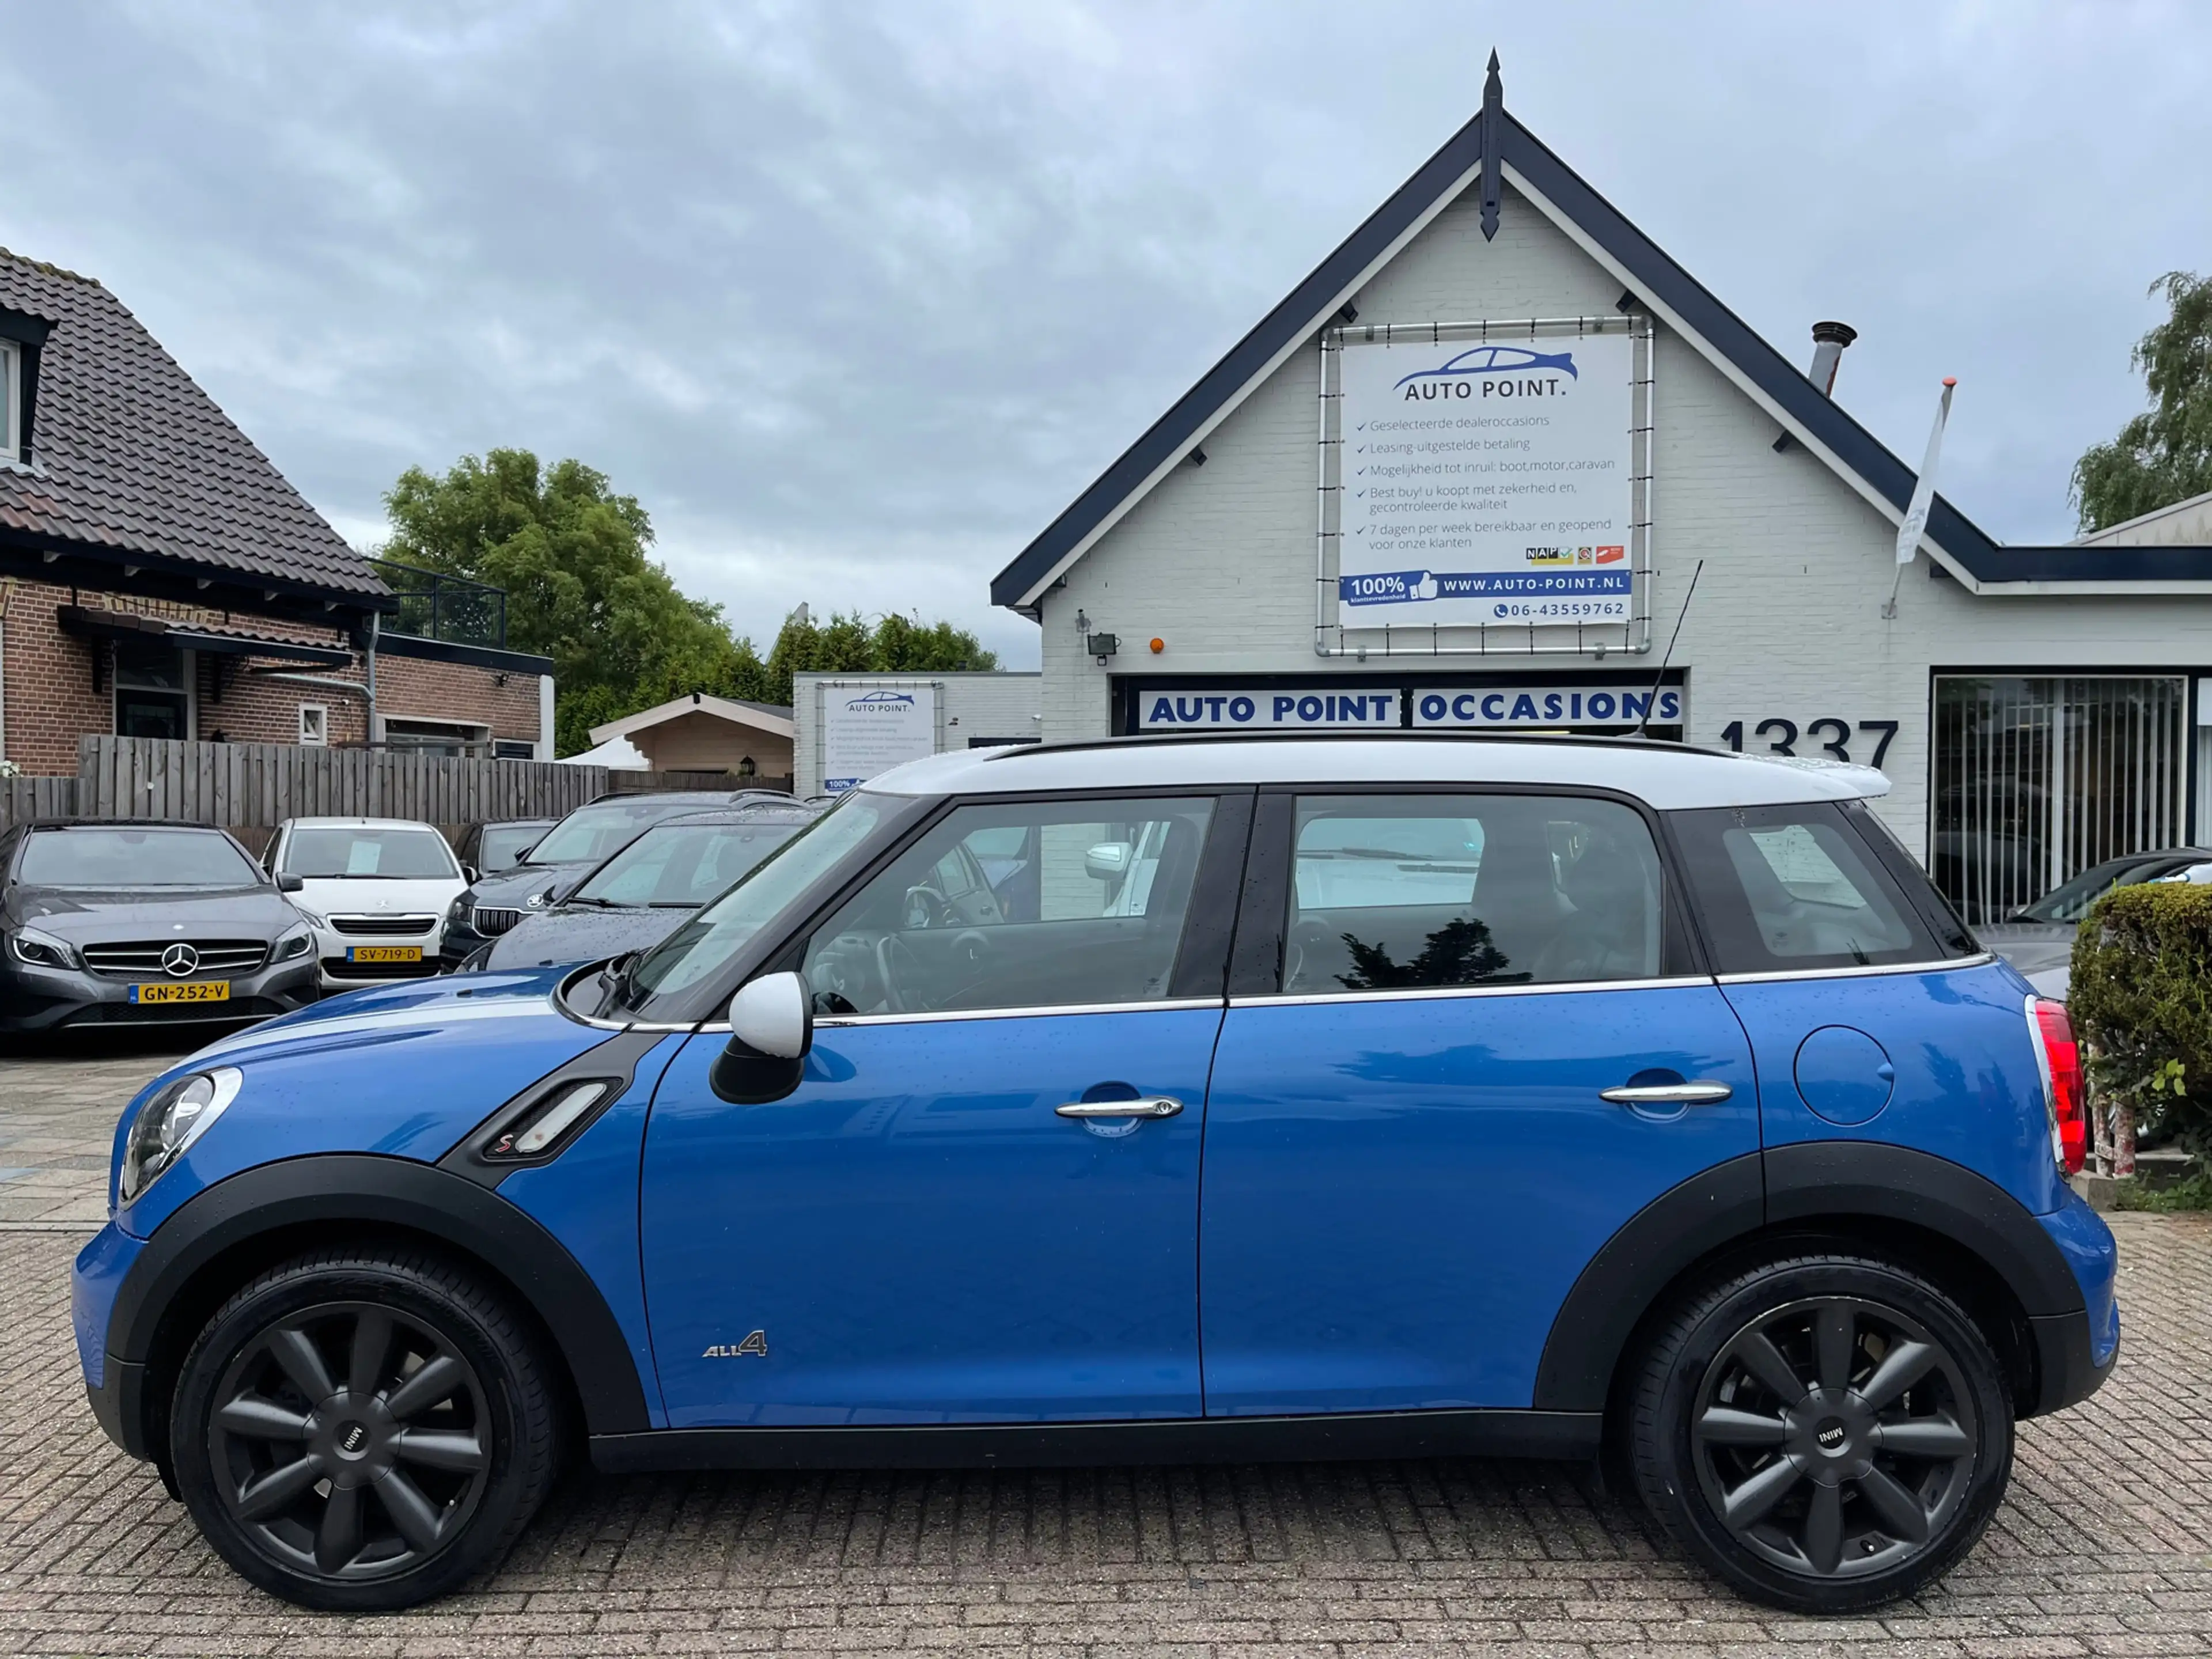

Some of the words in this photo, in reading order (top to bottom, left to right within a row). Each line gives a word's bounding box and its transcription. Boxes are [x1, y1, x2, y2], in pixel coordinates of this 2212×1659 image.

[1404, 382, 1472, 400] AUTO
[1483, 379, 1566, 398] POINT.
[1370, 418, 1453, 431] Geselecteerde
[1456, 416, 1550, 428] dealeroccasions
[1370, 440, 1480, 454] Leasing-uitgestelde
[1484, 438, 1531, 451] betaling
[1370, 464, 1441, 478] Mogelijkheid
[1445, 463, 1461, 473] tot
[1465, 462, 1497, 472] inruil:
[1370, 487, 1395, 498] Best
[1399, 486, 1422, 499] buy!
[1426, 487, 1433, 496] u
[1437, 486, 1469, 498] koopt
[1473, 485, 1495, 495] met
[1499, 483, 1556, 494] zekerheid
[1369, 501, 1457, 516] gecontroleerde
[1461, 499, 1508, 510] kwaliteit
[1370, 525, 1377, 535] 7
[1380, 524, 1415, 537] dagen
[1419, 525, 1438, 537] per
[1441, 522, 1472, 533] week
[1475, 521, 1536, 532] bereikbaar
[1540, 522, 1555, 531] en
[1559, 519, 1612, 533] geopend
[1369, 540, 1395, 550] voor
[1399, 540, 1426, 549] onze
[1430, 538, 1472, 549] klanten
[1527, 547, 1558, 558] NAP
[1351, 577, 1405, 596] 100%
[1444, 577, 1624, 591] WWW.AUTO-POINT.NL
[1512, 603, 1623, 616] 06-43559762
[1149, 696, 1256, 722] AUTO
[1273, 696, 1393, 722] POINT
[1420, 692, 1679, 721] OCCASIONS
[360, 949, 415, 960] SV-719-D
[145, 984, 224, 1001] GN-252-V
[495, 1134, 514, 1153] S
[344, 1426, 363, 1450] MINI
[1819, 1427, 1843, 1442] MINI
